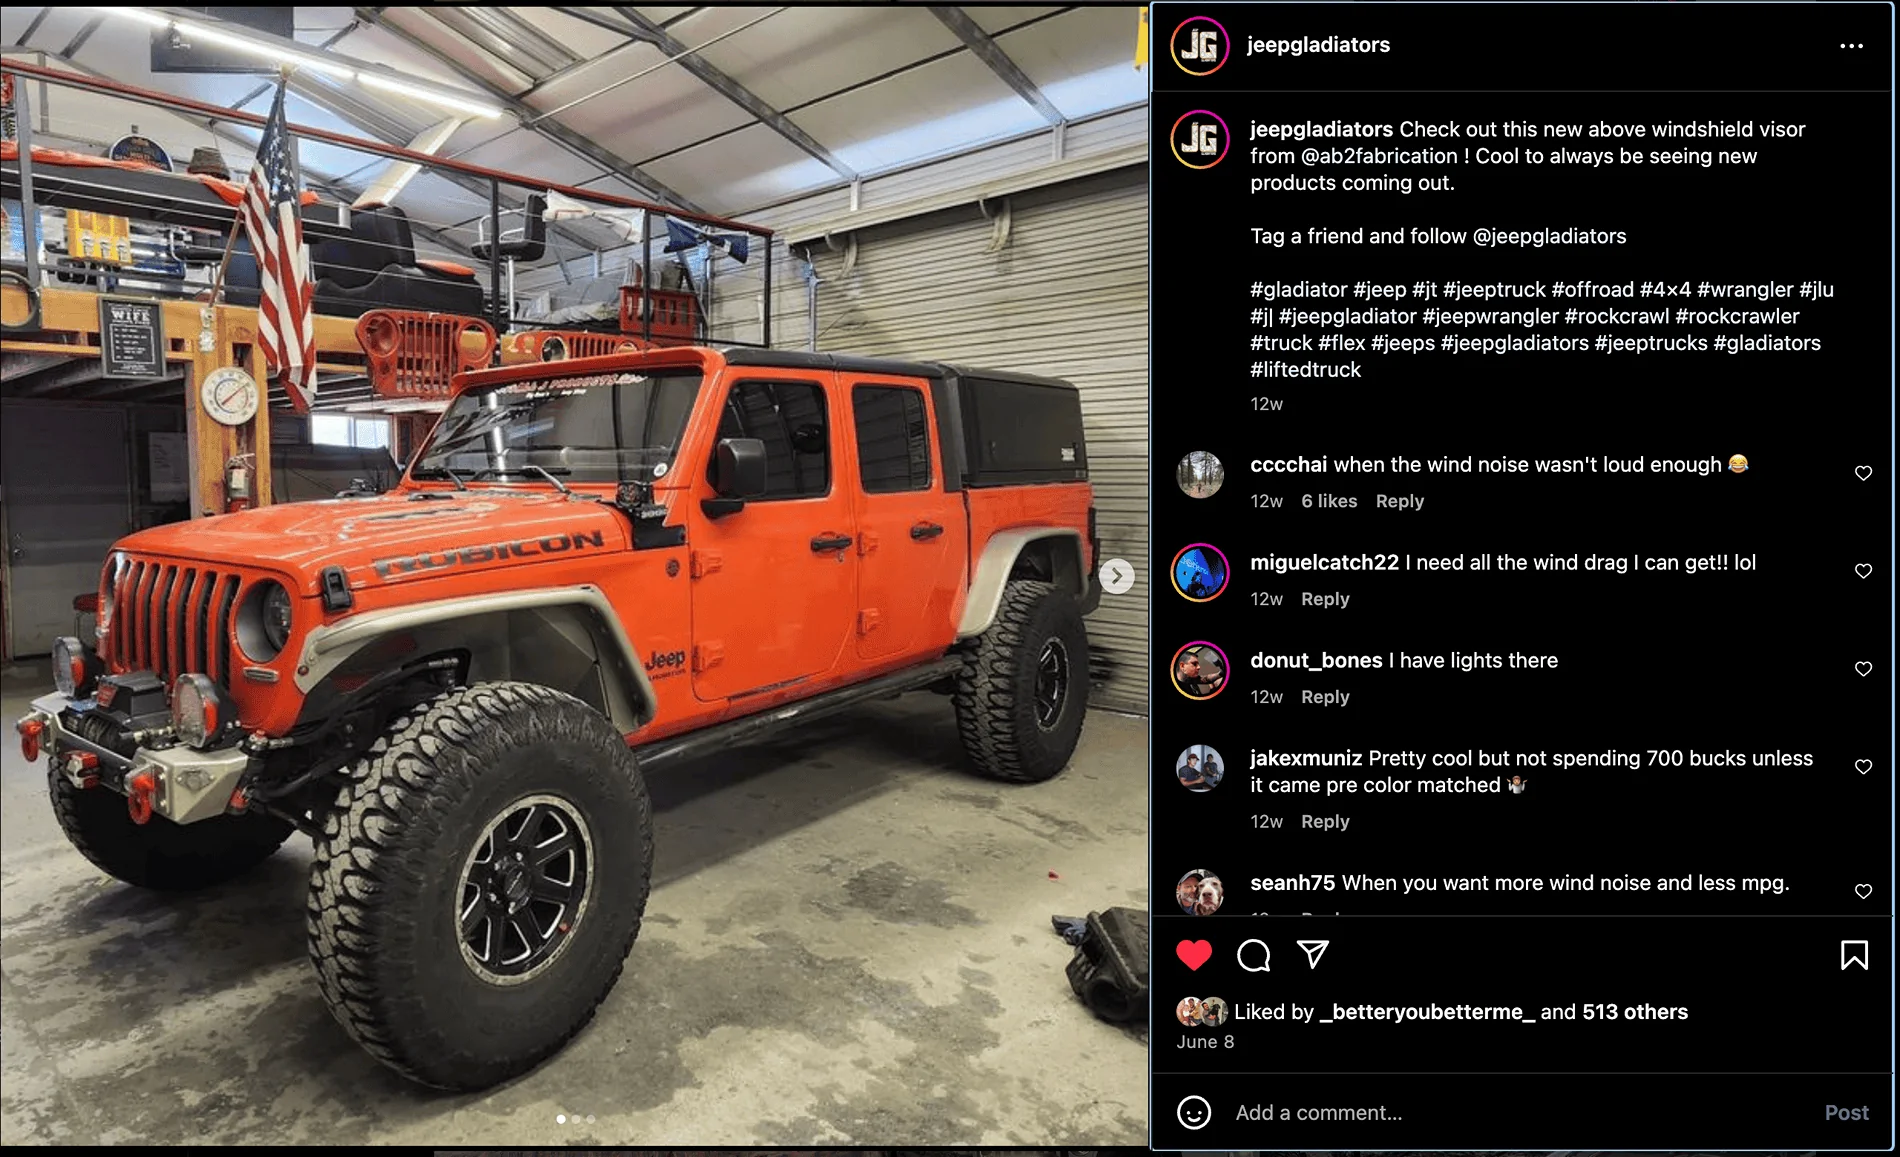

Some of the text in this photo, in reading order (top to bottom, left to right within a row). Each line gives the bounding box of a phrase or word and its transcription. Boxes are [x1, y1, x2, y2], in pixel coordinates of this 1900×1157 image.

[1181, 31, 1217, 59] JG
[1247, 35, 1390, 56] jeepgladiators
[1181, 124, 1217, 153] JG
[1250, 120, 1806, 141] jeepgladiators Check out this new above windshield visor
[1250, 147, 1757, 167] from @ab2fabrication ! Cool to always be seeing new
[1252, 174, 1454, 194] products coming out.
[1251, 227, 1626, 247] Tag a friend and follow @jeepgladiators
[1250, 281, 1348, 301] #gladiator
[1353, 281, 1406, 301] #jeep
[1412, 281, 1437, 301] #jt
[1443, 281, 1546, 301] #jeeptruck
[1552, 281, 1633, 297] #offroad
[1697, 281, 1794, 301] #wrangler
[1800, 281, 1833, 301] #jlu
[112, 311, 150, 321] WIFE
[1279, 307, 1417, 327] #jeepgladiator
[1423, 308, 1559, 327] #jeepwrangler
[1565, 308, 1669, 324] #rockcrawl
[1676, 308, 1800, 324] #rockcrawler
[1250, 334, 1821, 354] #truck #flex #jeeps #jeepgladiators #jeeptrucks #gladiators
[1250, 361, 1361, 377] #liftedtruck
[1251, 397, 1283, 410] 12w
[1251, 455, 1721, 475] cccchai when the wind noise wasn't loud enough
[1251, 493, 1424, 511] 12w 6 likes Reply
[374, 531, 604, 577] RUBICON
[1251, 553, 1755, 574] miguelcatch22 I need all the wind drag I can get!! lol
[1251, 592, 1350, 609] 12w Reply
[644, 650, 686, 670] Jeep
[1251, 652, 1558, 672] donut_bones I have lights there
[1251, 690, 1350, 707] 12w Reply
[1250, 749, 1813, 769] jakexmuniz Pretty cool but not spending 700 bucks unless
[1251, 776, 1500, 796] it came pre color matched
[1251, 814, 1350, 831] 12w Reply
[1251, 874, 1789, 894] seanh75 When you want more wind noise and less mpg.
[1236, 1003, 1688, 1023] Liked by _betteryoubetterme_ and 513 others
[1177, 1035, 1234, 1048] June 8
[1236, 1104, 1273, 1120] Add
[1280, 1108, 1290, 1120] a
[1826, 1105, 1869, 1120] Post
